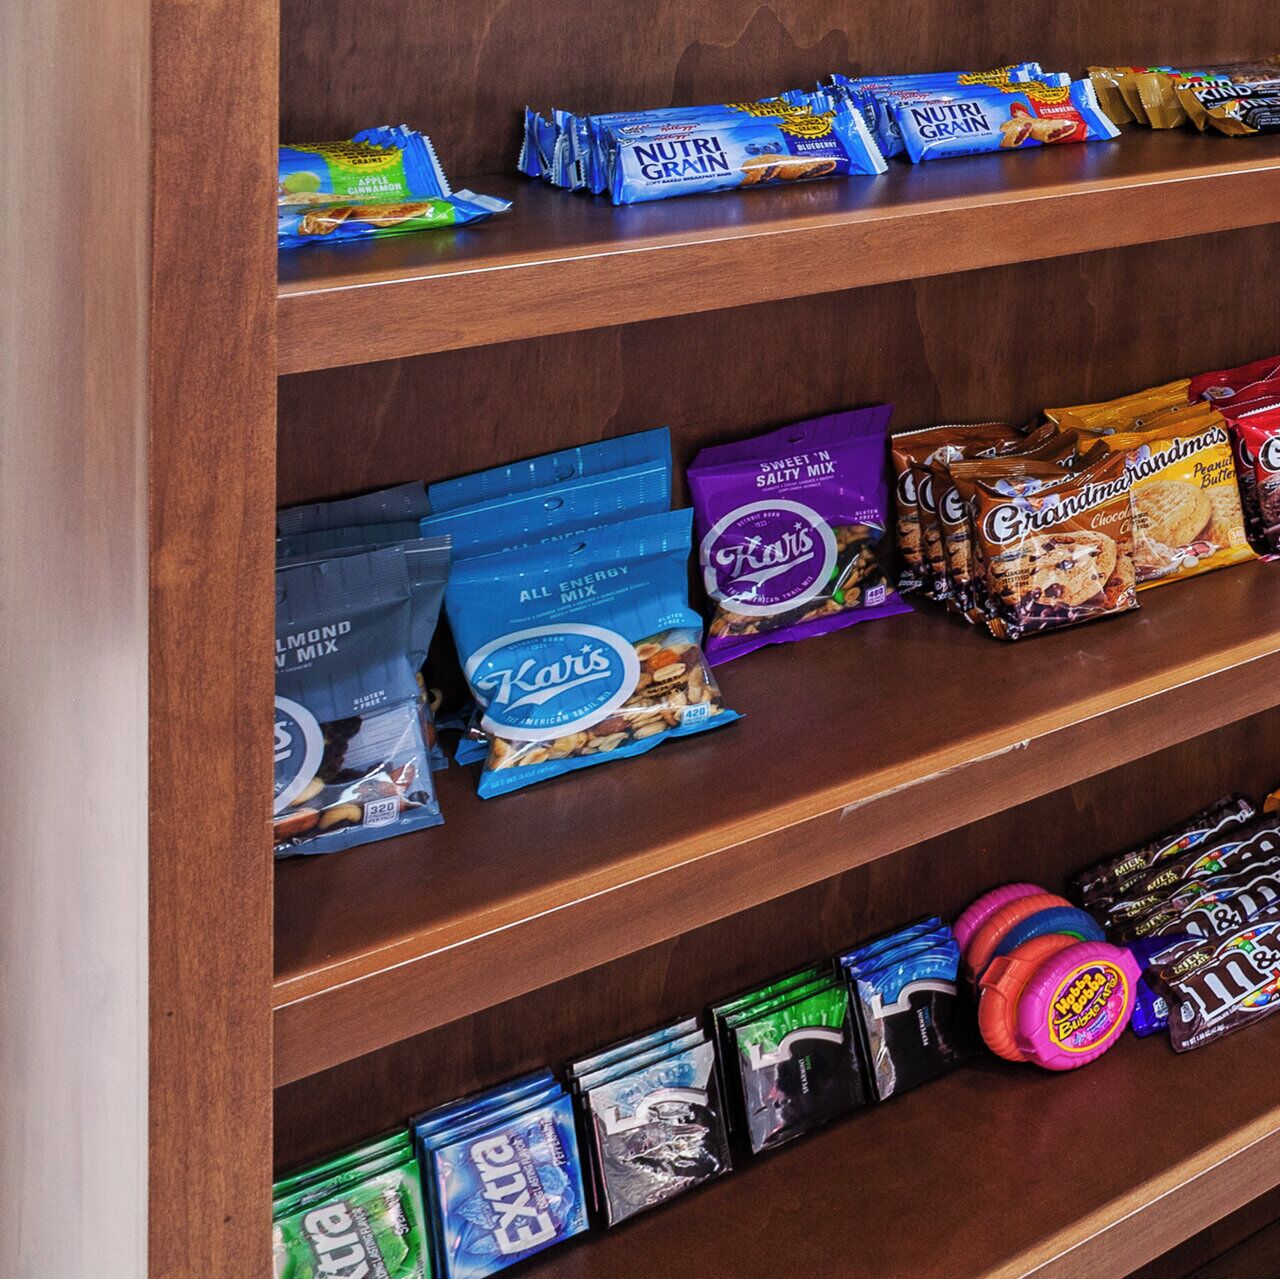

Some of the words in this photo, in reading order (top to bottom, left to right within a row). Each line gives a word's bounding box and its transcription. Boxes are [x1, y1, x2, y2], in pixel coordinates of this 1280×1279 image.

[1197, 84, 1252, 103] KIND
[910, 101, 982, 127] NUTRI
[918, 117, 991, 139] GRAIN
[633, 136, 722, 166] NUTRI
[796, 140, 838, 151] BLUEBERRY
[640, 153, 730, 180] GRAIN
[347, 183, 403, 196] CINNAMON
[358, 175, 389, 186] APPLE
[755, 469, 801, 488] SALTY
[806, 462, 836, 477] MIX
[759, 455, 810, 473] SWEET
[1193, 455, 1235, 478] Peanut
[1200, 468, 1238, 490] Butter
[715, 521, 814, 577] Kar's
[519, 586, 552, 603] ALL
[558, 565, 630, 594] ENERGY
[559, 584, 598, 606] MIX
[296, 638, 339, 664] MIX
[476, 643, 611, 705] Kar's
[353, 689, 386, 705] GLUTEN
[524, 712, 570, 728] AMERICAN
[685, 707, 707, 719] 420
[370, 802, 395, 816] 320
[1114, 855, 1146, 876] MILK
[1147, 869, 1176, 891] MILK
[1055, 973, 1092, 1015] Hubba
[469, 1133, 558, 1257] Extra
